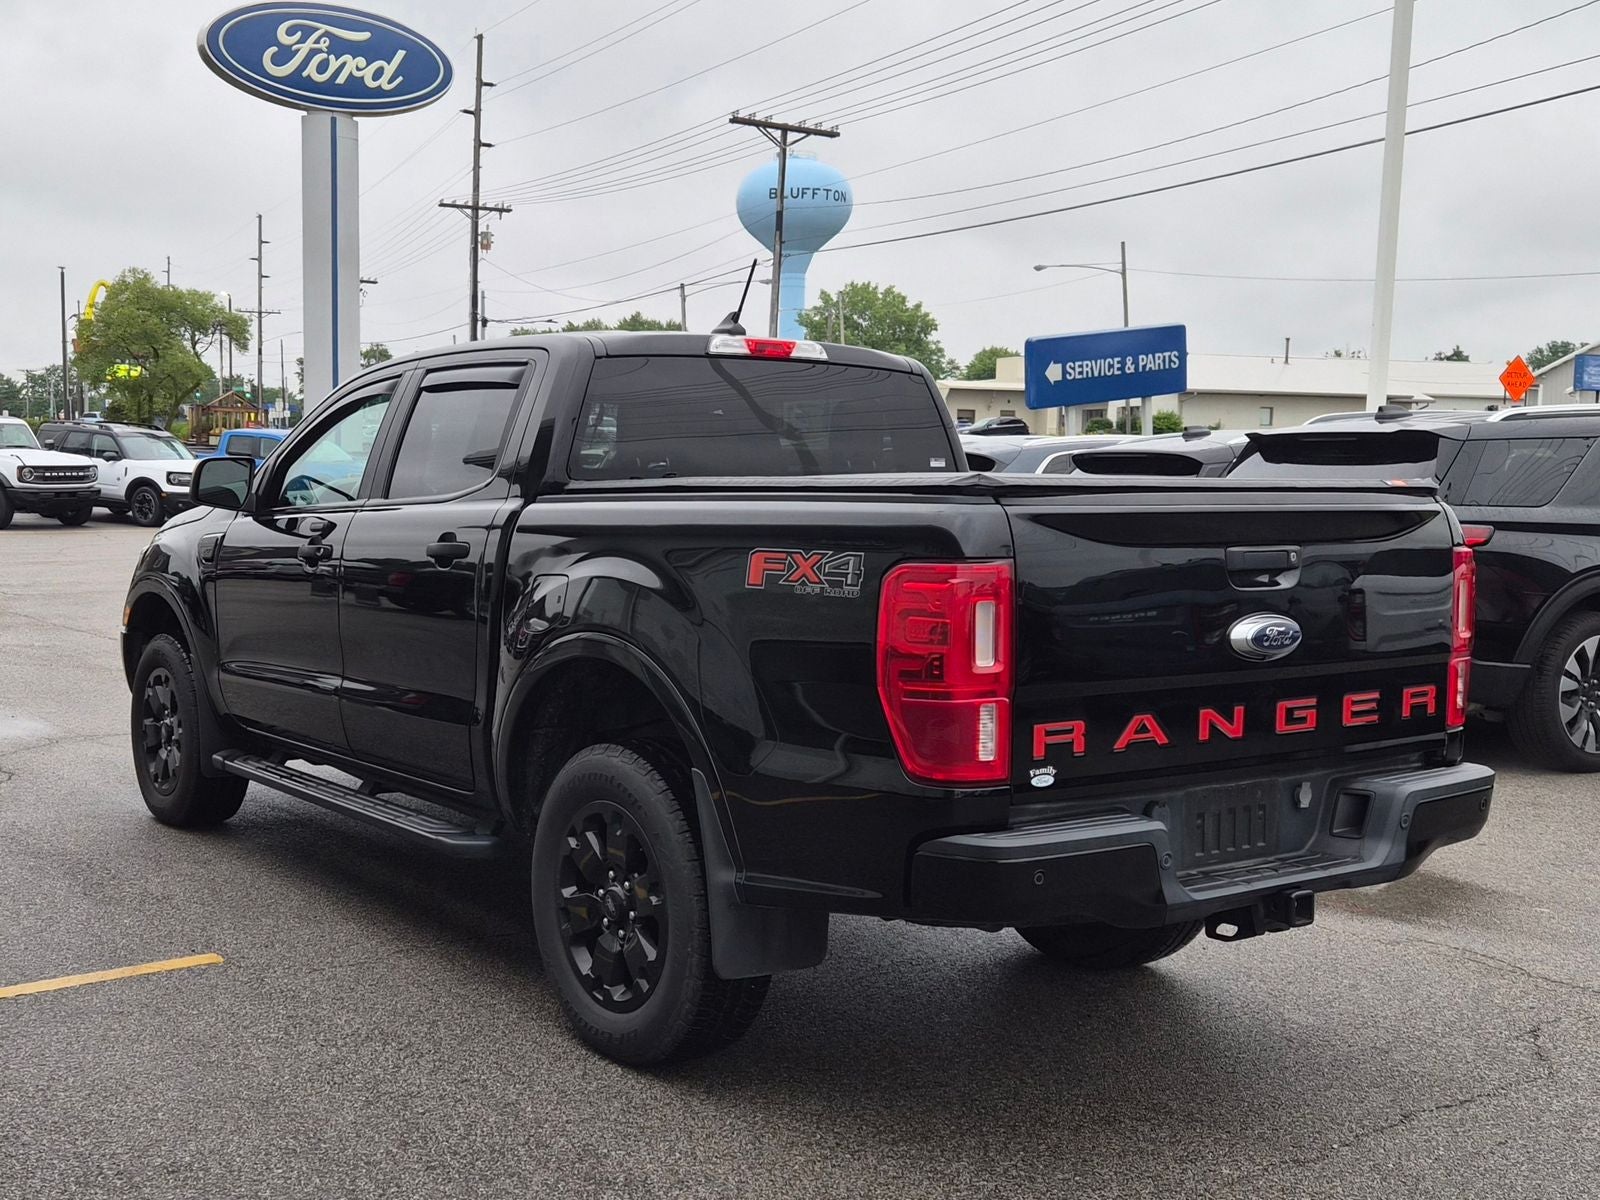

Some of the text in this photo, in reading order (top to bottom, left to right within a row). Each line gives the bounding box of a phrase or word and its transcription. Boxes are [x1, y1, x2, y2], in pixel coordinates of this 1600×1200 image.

[262, 19, 407, 91] Ford
[769, 187, 847, 203] BUFFTON
[1066, 351, 1180, 380] SERVICE & PARTS
[745, 548, 864, 589] FX4
[794, 585, 861, 598] OFF ROAD
[1263, 626, 1293, 647] Ford
[1032, 684, 1437, 760] RANGER
[1030, 765, 1057, 778] Family
